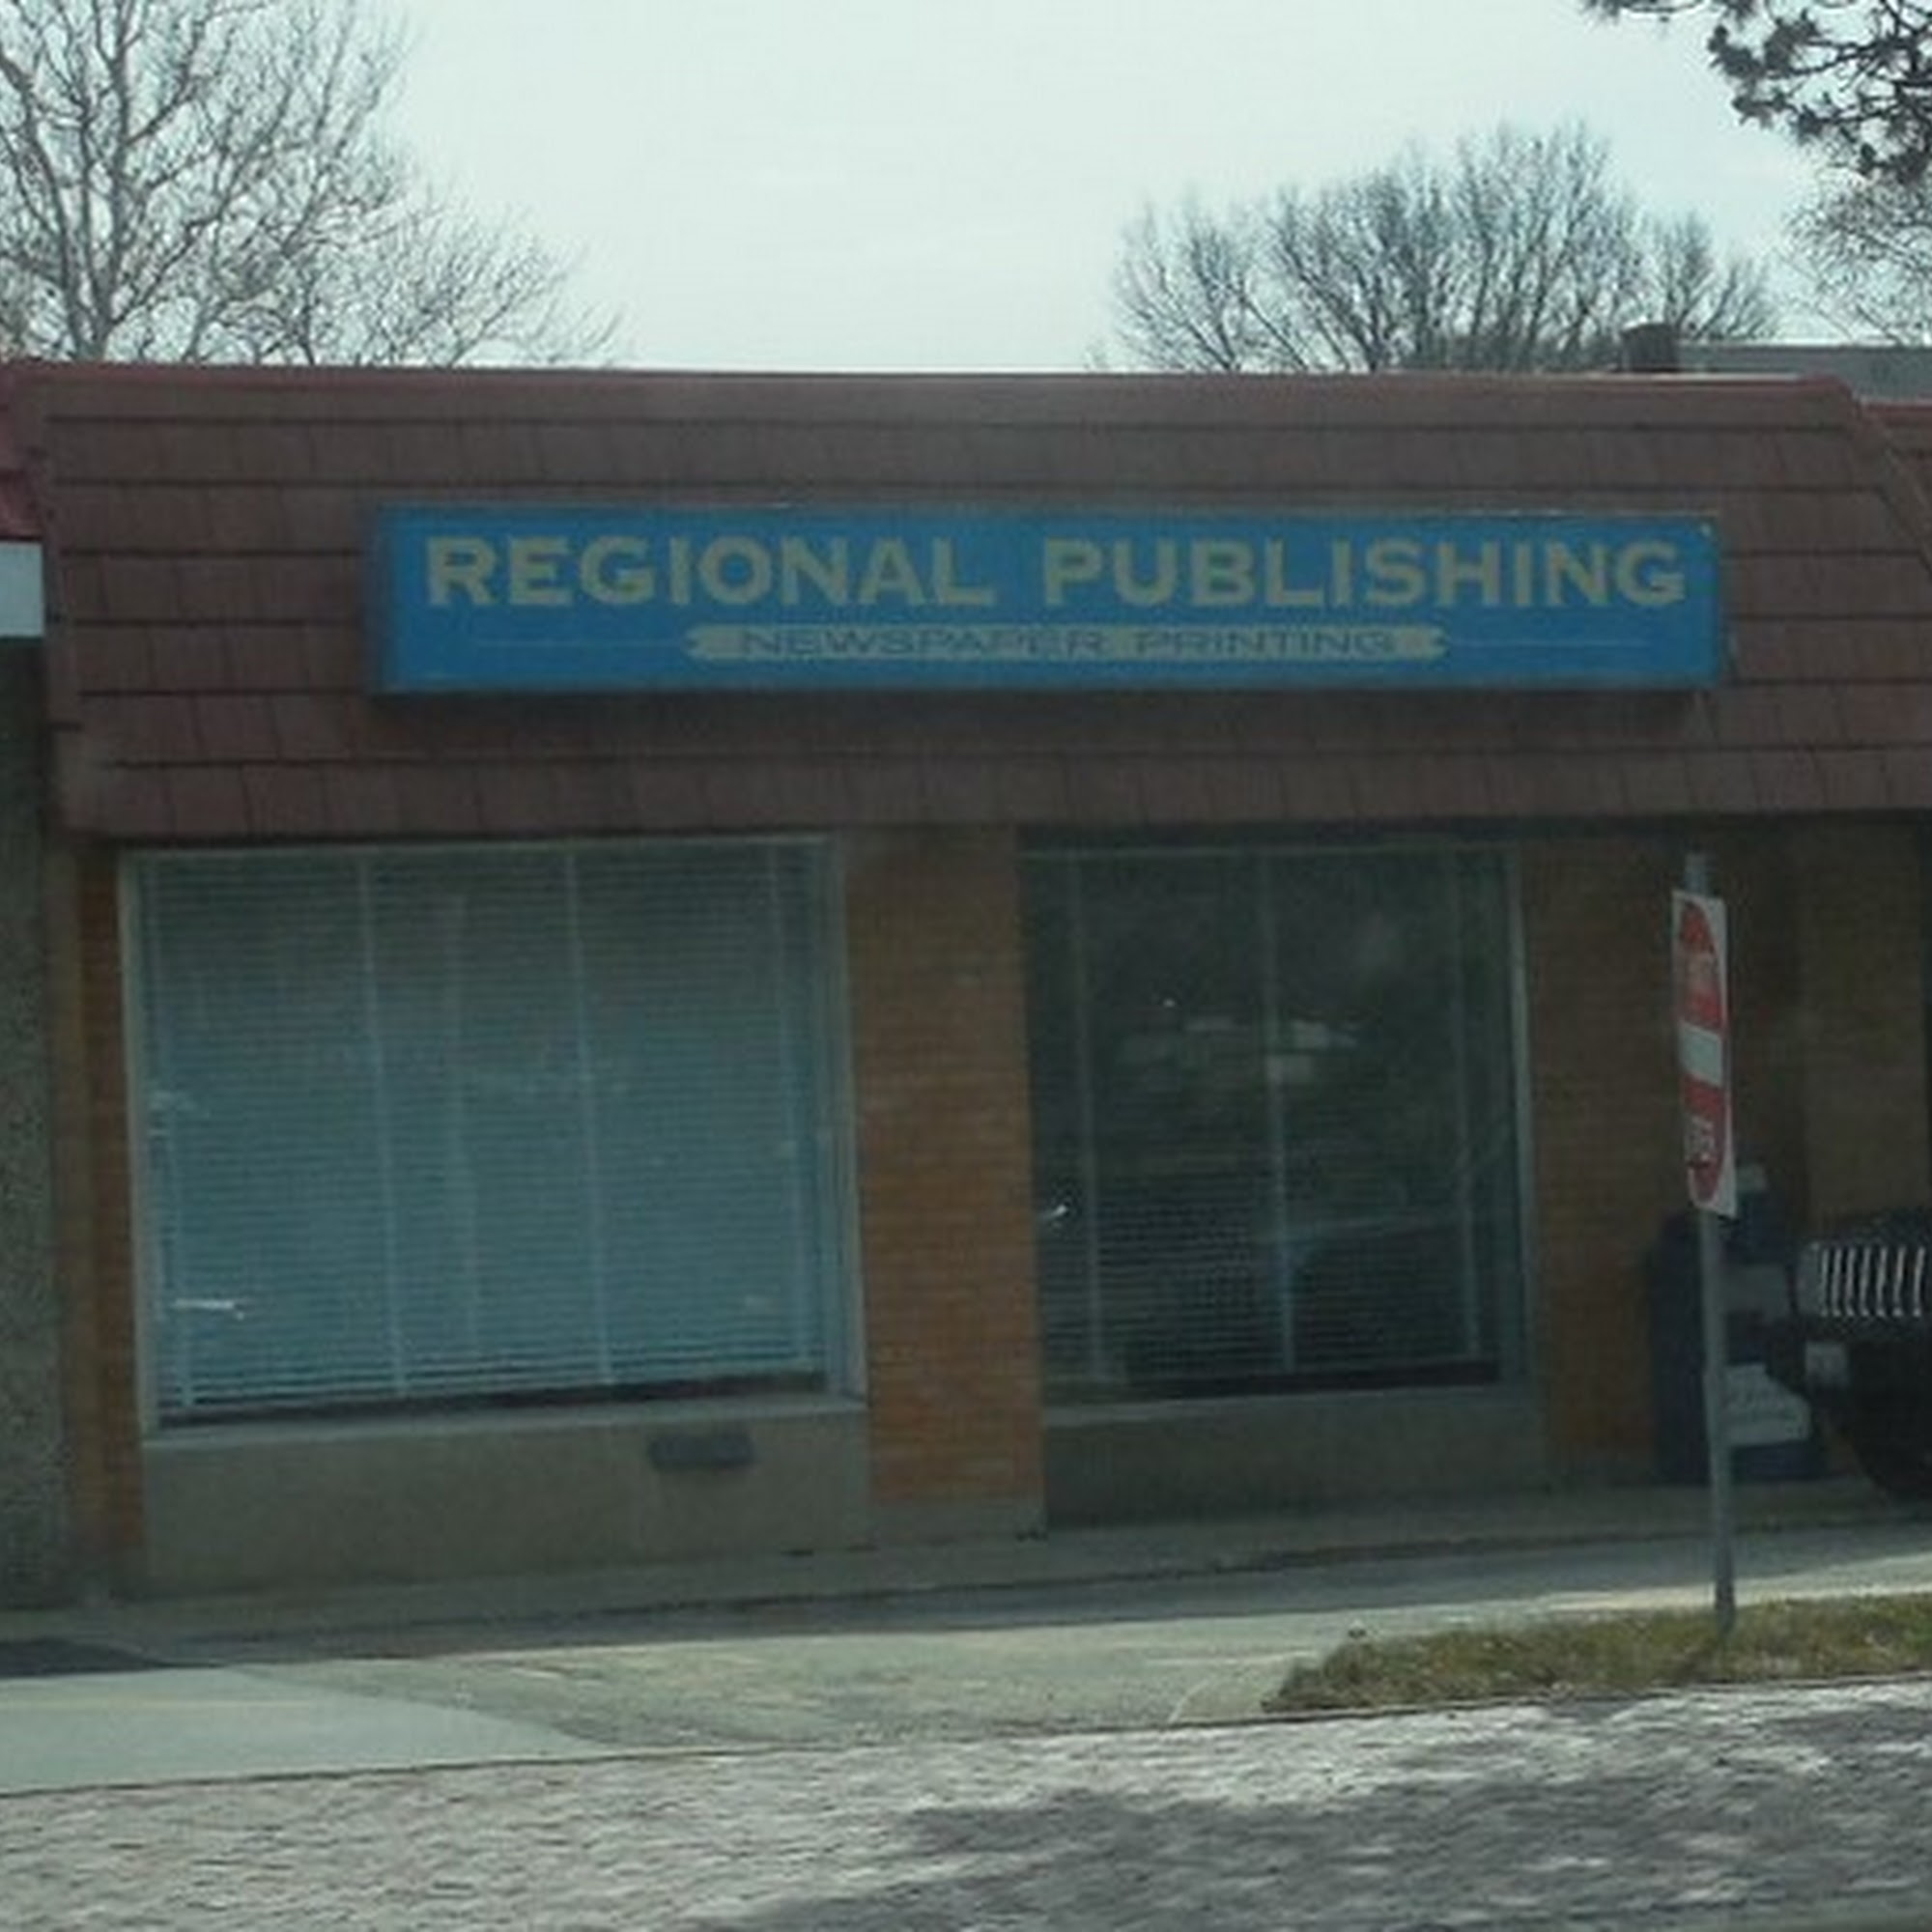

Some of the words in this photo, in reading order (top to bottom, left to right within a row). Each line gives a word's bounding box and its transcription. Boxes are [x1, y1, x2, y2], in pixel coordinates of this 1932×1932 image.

[426, 536, 995, 608] REGIONAL
[1042, 538, 1687, 609] PUBLISHING
[742, 628, 1108, 660] NEWSPAPER
[1137, 628, 1397, 659] PRINTING
